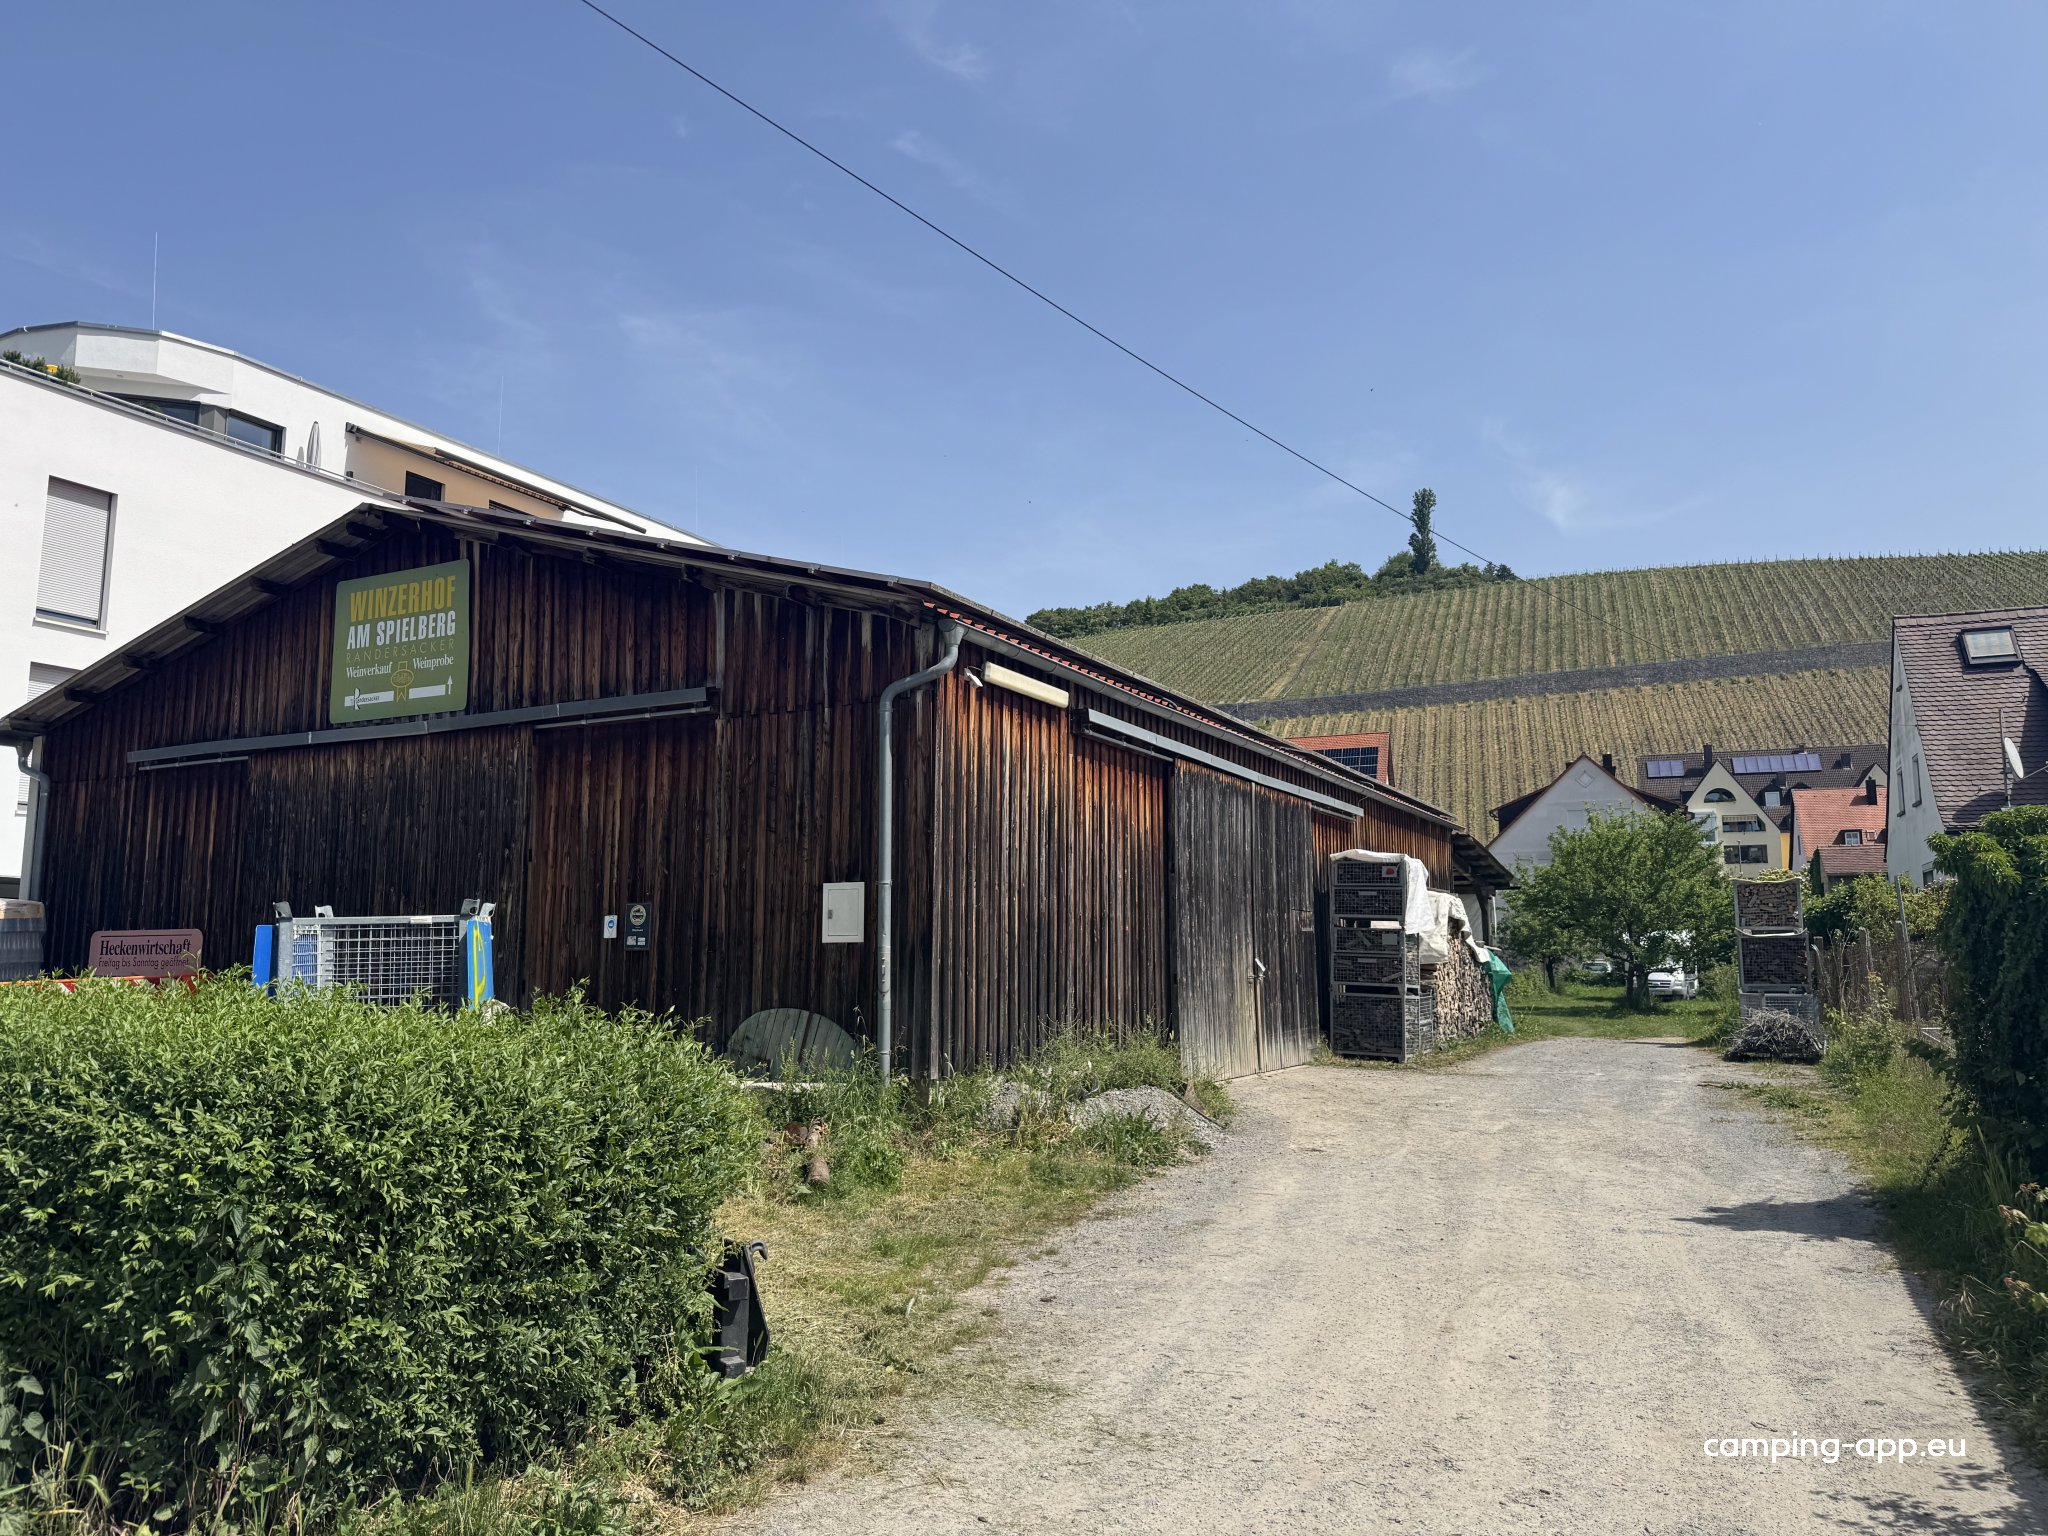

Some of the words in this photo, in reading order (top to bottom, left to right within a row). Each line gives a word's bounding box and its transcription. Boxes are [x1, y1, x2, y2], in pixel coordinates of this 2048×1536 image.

[350, 575, 456, 622] WINZERHOF
[347, 624, 370, 650] AM
[376, 610, 456, 646] SPIELBERG
[346, 638, 455, 663] RANDERSACKER
[346, 661, 393, 679] Weinverkauf
[413, 654, 454, 671] Weinprobe
[99, 939, 192, 956] Heckenwirtschaft
[98, 957, 120, 970] Freitag
[121, 957, 130, 967] bis
[132, 956, 159, 970] Sonntag
